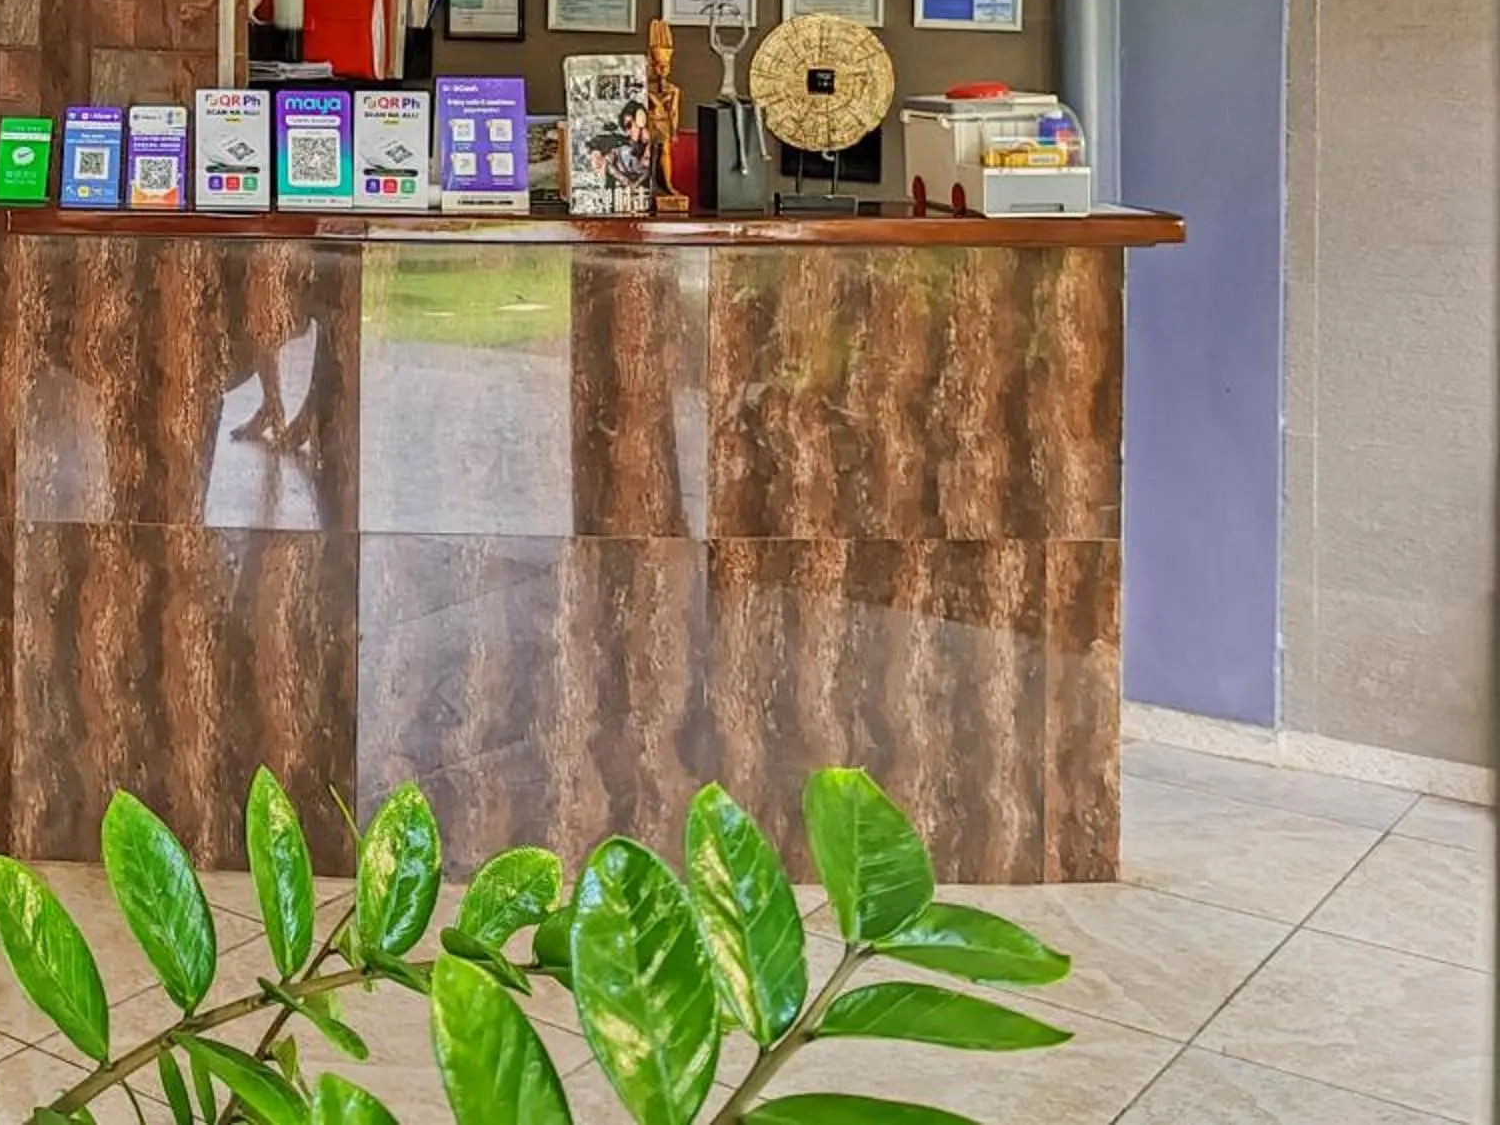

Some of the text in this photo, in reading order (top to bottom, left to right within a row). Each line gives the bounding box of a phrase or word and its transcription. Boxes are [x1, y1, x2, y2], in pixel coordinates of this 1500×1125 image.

[219, 94, 261, 107] QR Ph
[284, 97, 342, 115] maya
[378, 96, 421, 109] QR Ph
